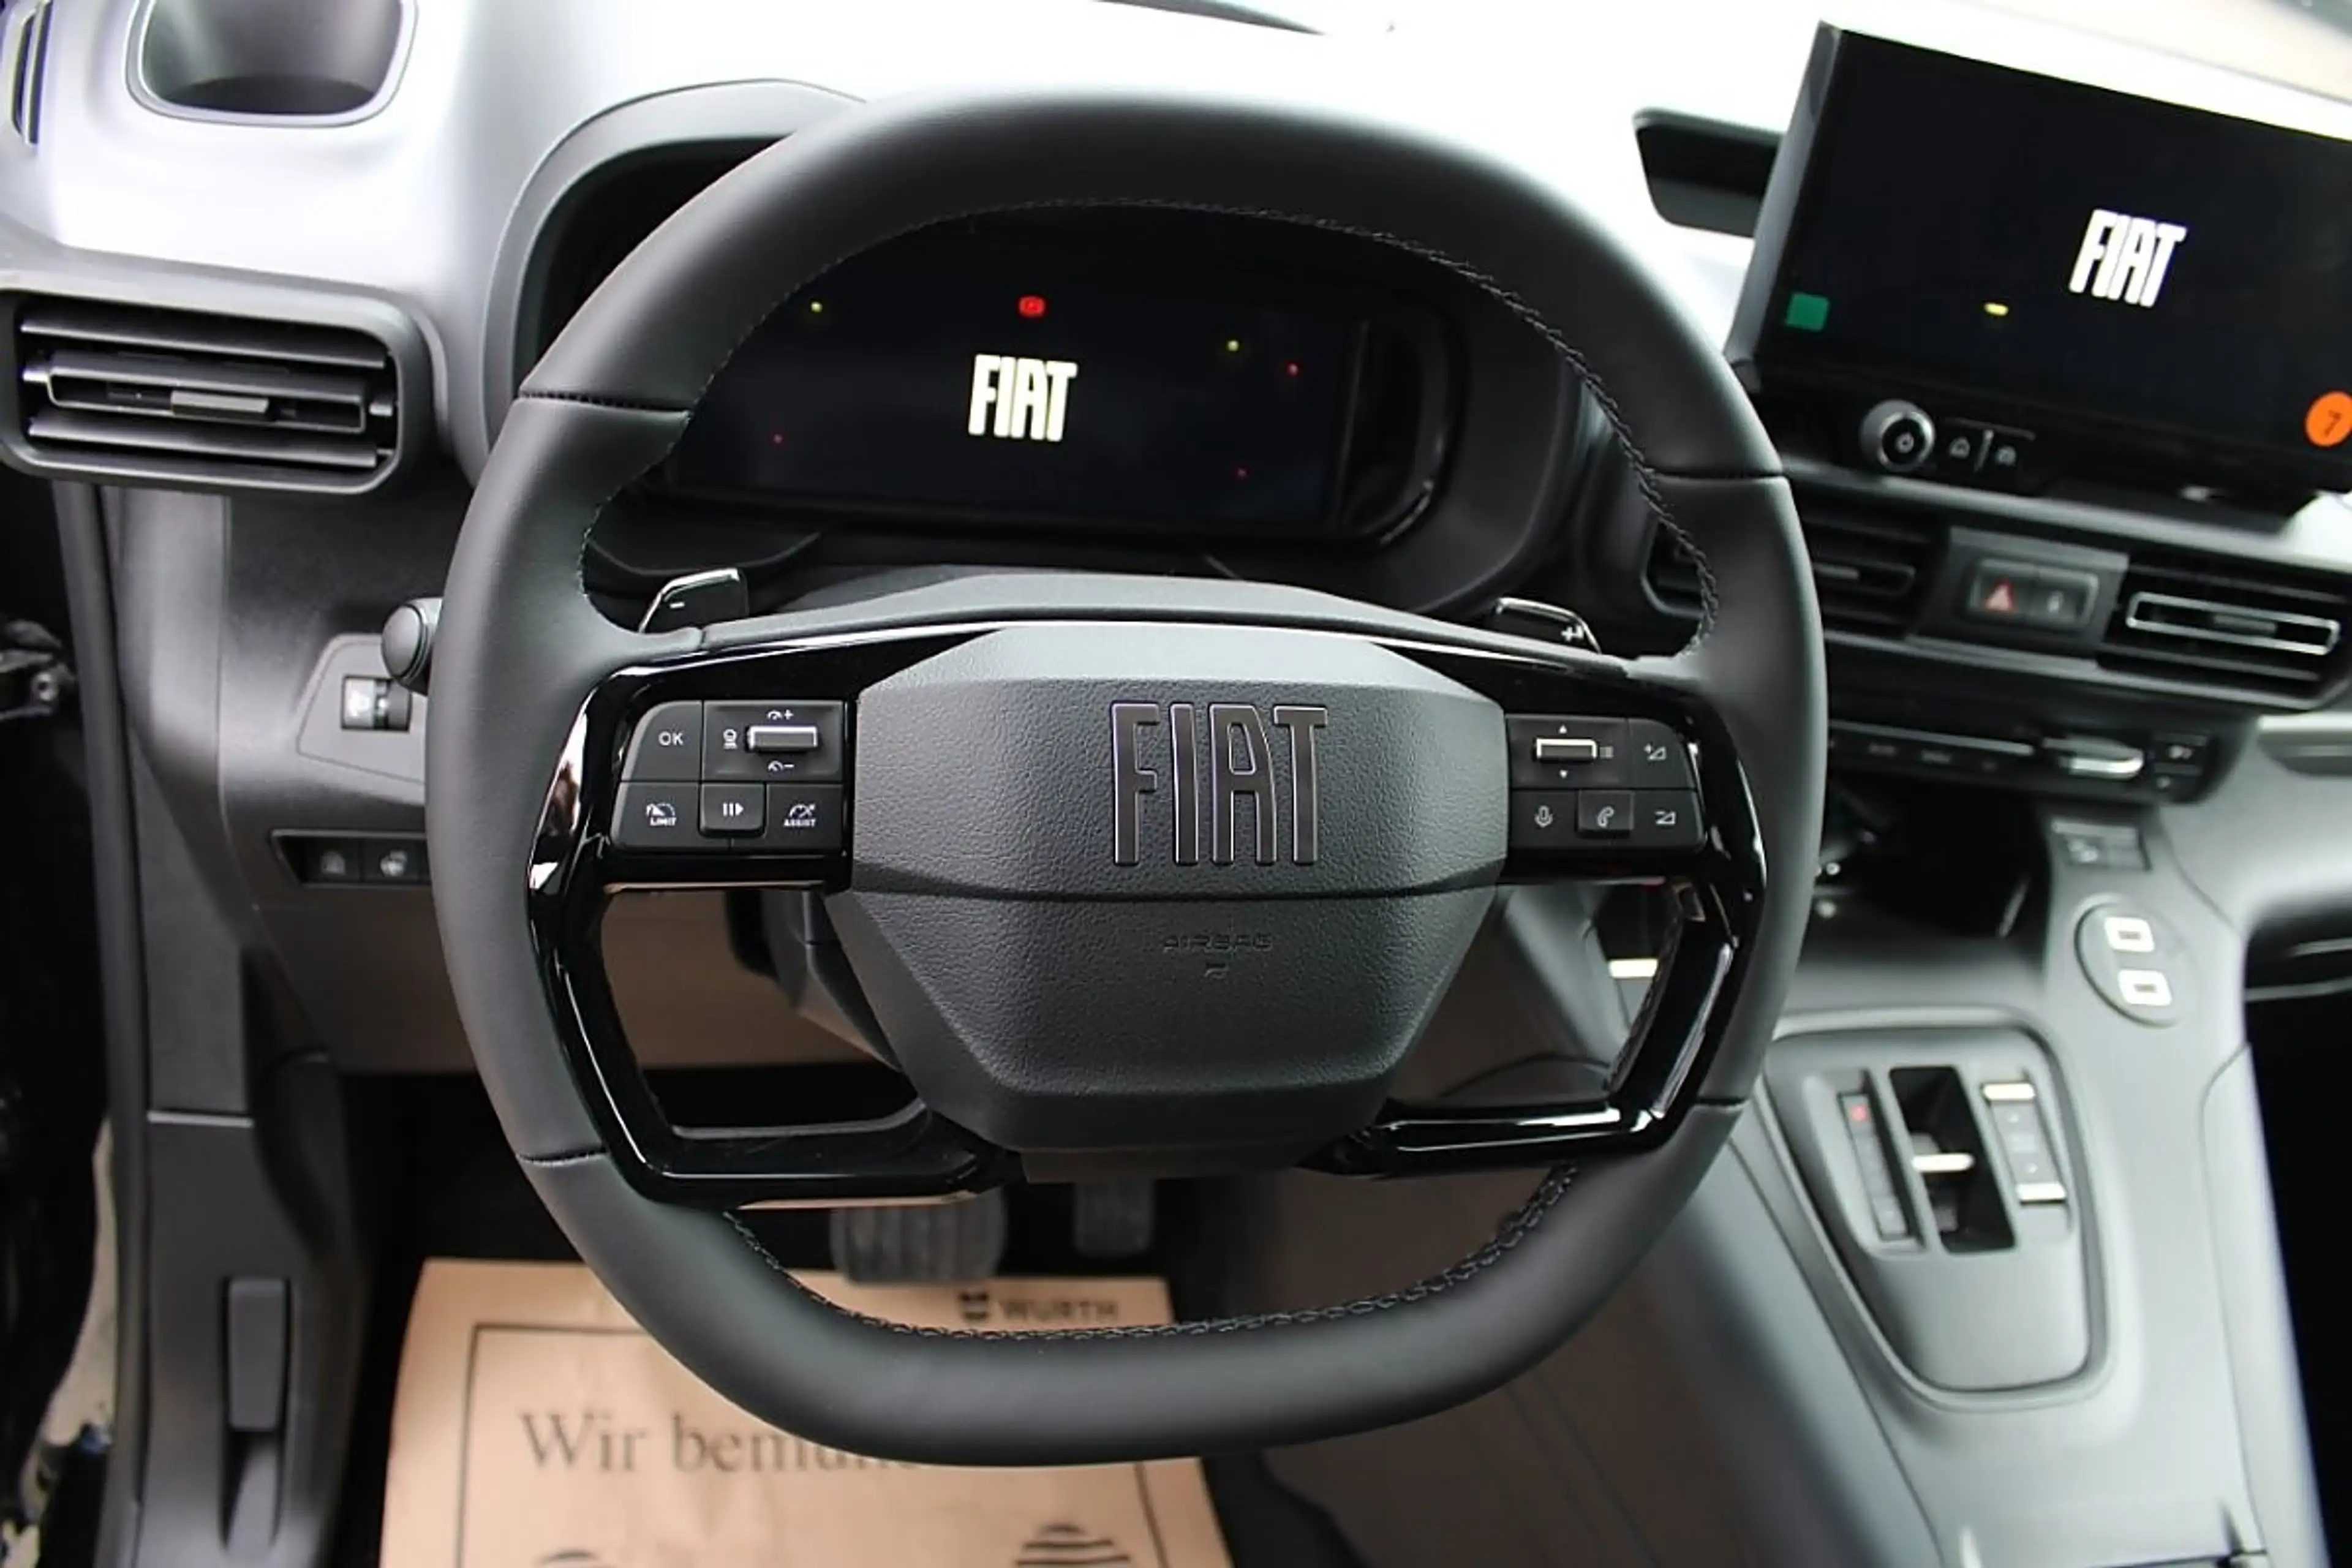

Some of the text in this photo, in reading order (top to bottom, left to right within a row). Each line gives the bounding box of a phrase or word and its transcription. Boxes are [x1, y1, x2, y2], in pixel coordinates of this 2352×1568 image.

[2069, 208, 2187, 308] FIAT
[968, 353, 1078, 442] FIAT
[658, 731, 684, 746] OK
[1111, 701, 1328, 865] FIAT
[650, 816, 677, 827] LIMIT
[783, 818, 816, 827] ASSIST
[521, 1411, 649, 1472] Wir
